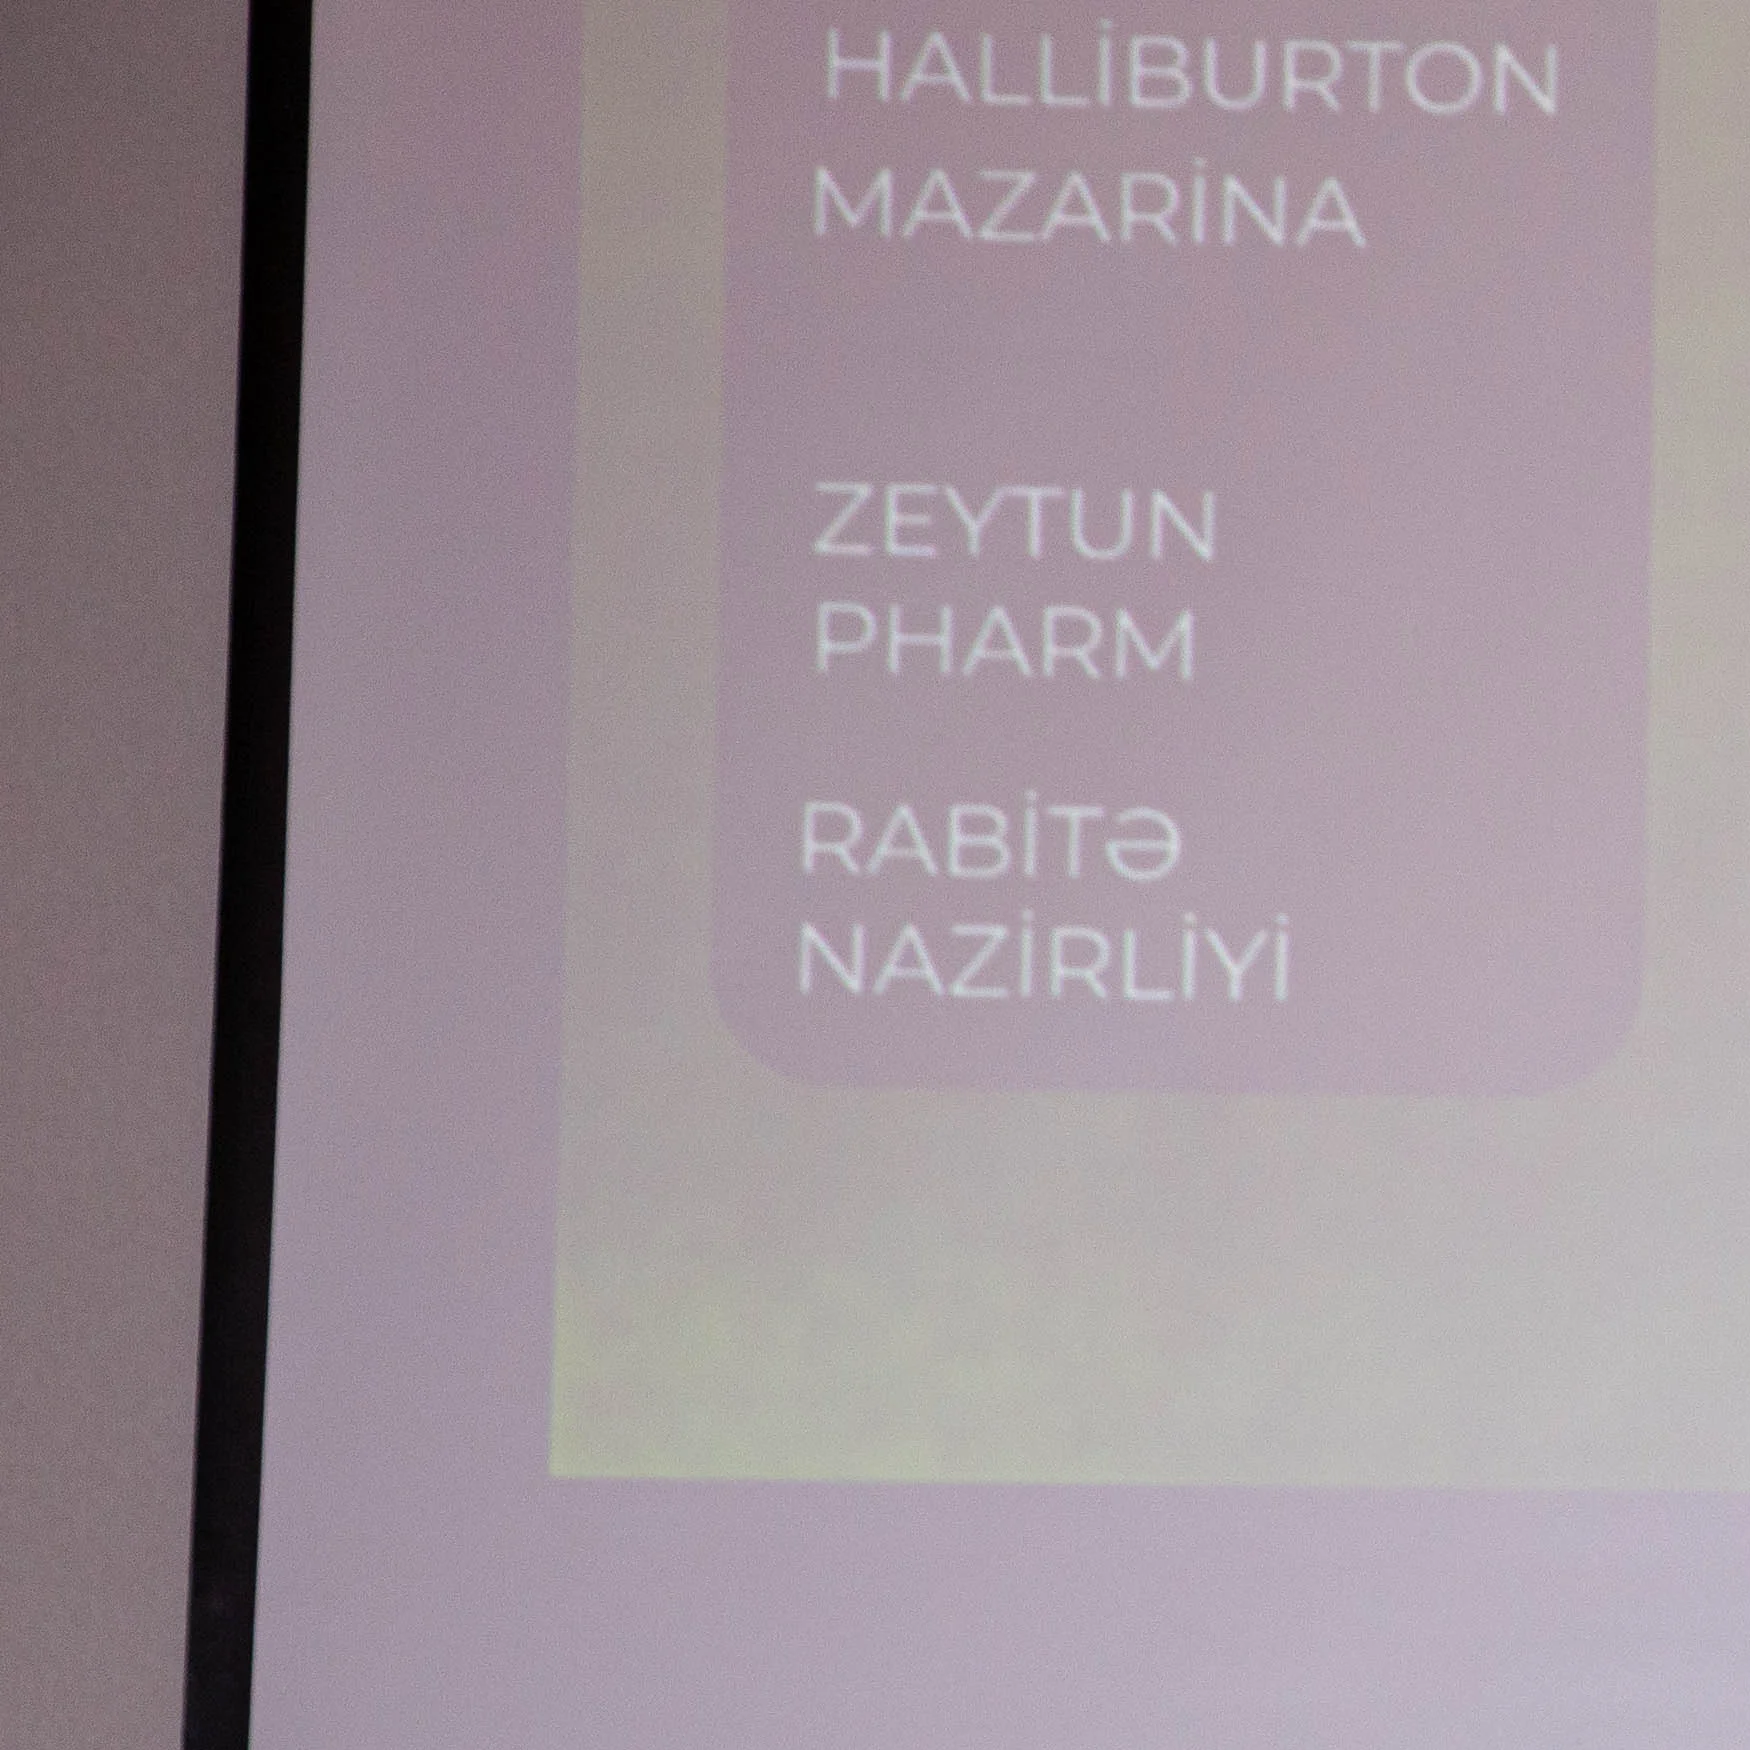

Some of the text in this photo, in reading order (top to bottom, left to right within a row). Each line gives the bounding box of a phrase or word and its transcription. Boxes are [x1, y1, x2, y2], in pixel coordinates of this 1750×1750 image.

[827, 19, 1560, 117] HALLİBURTON
[814, 158, 1367, 248] MAZARİNA
[813, 482, 1215, 563] ZEYTUN
[815, 601, 1196, 681] PHARM
[801, 790, 1183, 882] RABİTƏ
[800, 910, 1290, 1003] NAZİRLİYİ
